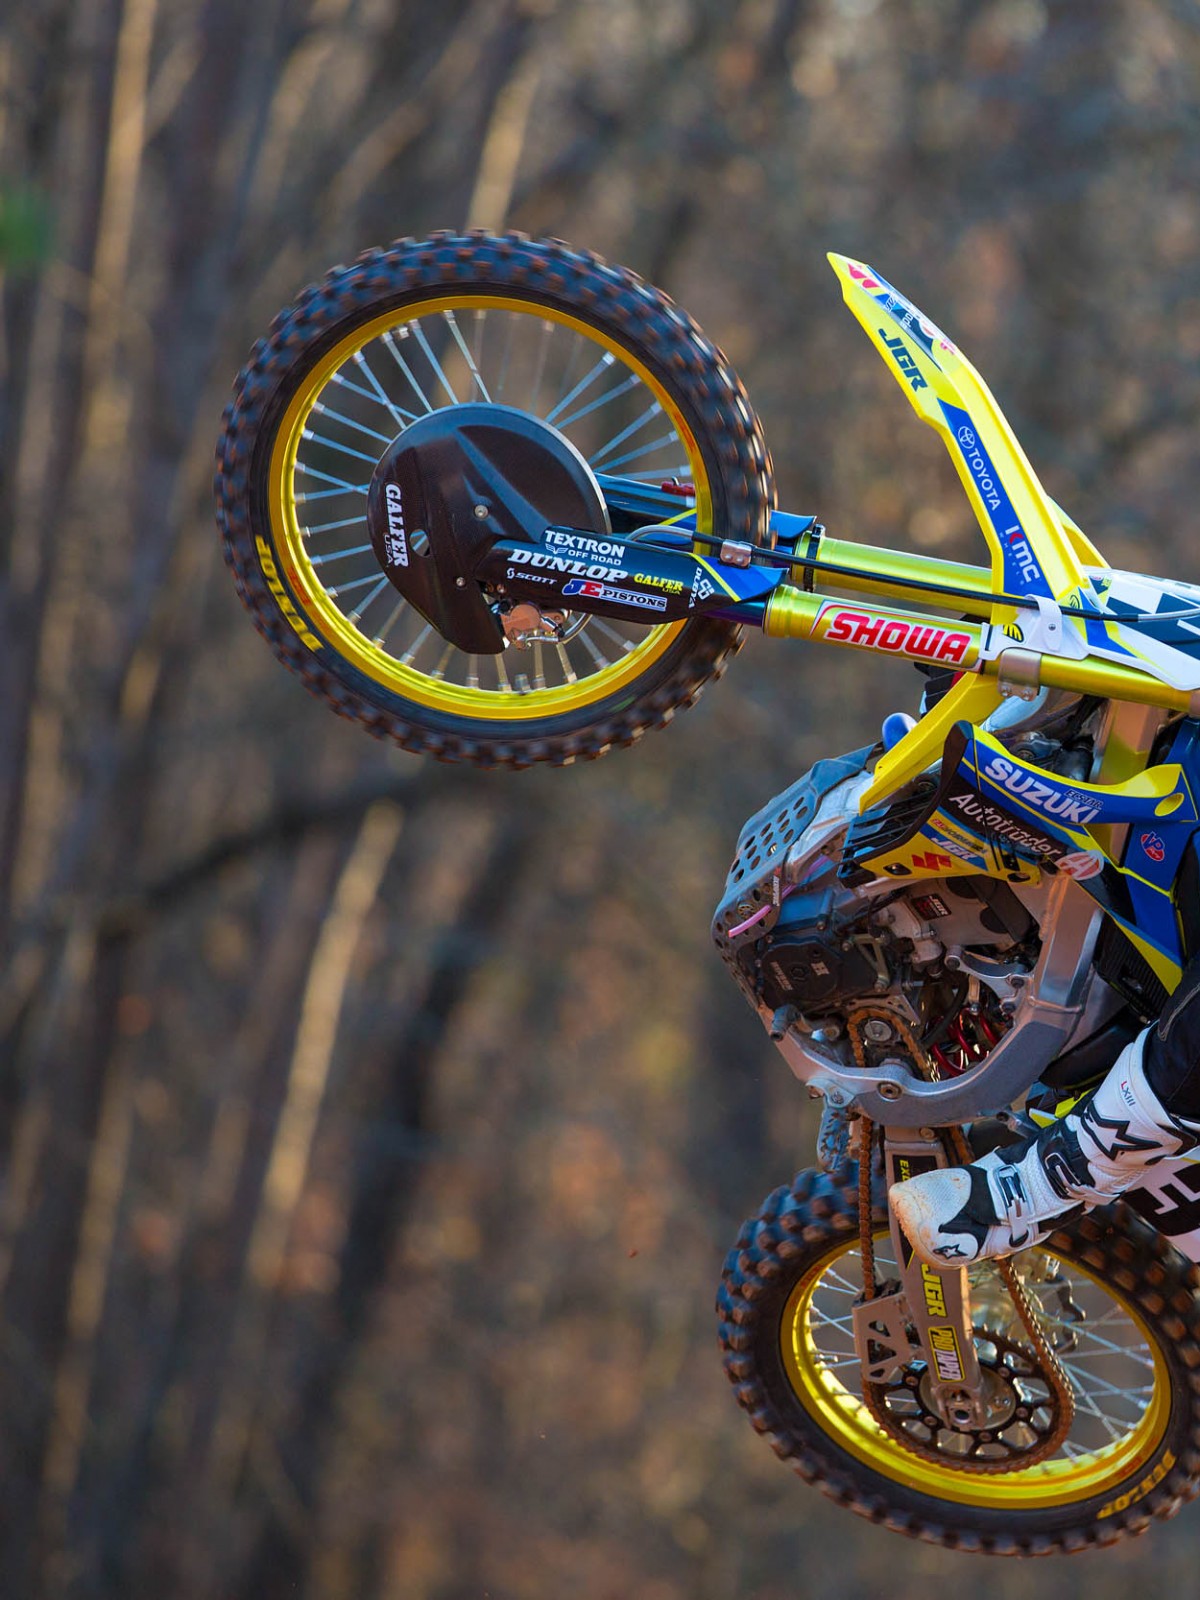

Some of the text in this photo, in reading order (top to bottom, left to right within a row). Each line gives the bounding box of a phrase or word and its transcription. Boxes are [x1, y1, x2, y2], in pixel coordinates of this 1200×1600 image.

[878, 328, 928, 392] JGR
[968, 448, 1001, 511] TOYOTA
[385, 483, 409, 567] GALFER
[384, 534, 394, 564] USA
[544, 530, 626, 559] TEXTRON
[567, 550, 622, 567] OFF ROAD
[507, 548, 629, 583] DUNLOP
[515, 571, 558, 585] SCOTT
[633, 573, 684, 591] GALFER
[661, 586, 682, 595] USA
[602, 589, 666, 609] PISTONS
[824, 611, 973, 665] SHOWA
[985, 757, 1099, 824] SUZUKI
[1064, 790, 1104, 810] ECSTAR
[949, 793, 1062, 857] Autotrader
[930, 836, 977, 861] JGR
[920, 1263, 948, 1318] JGR
